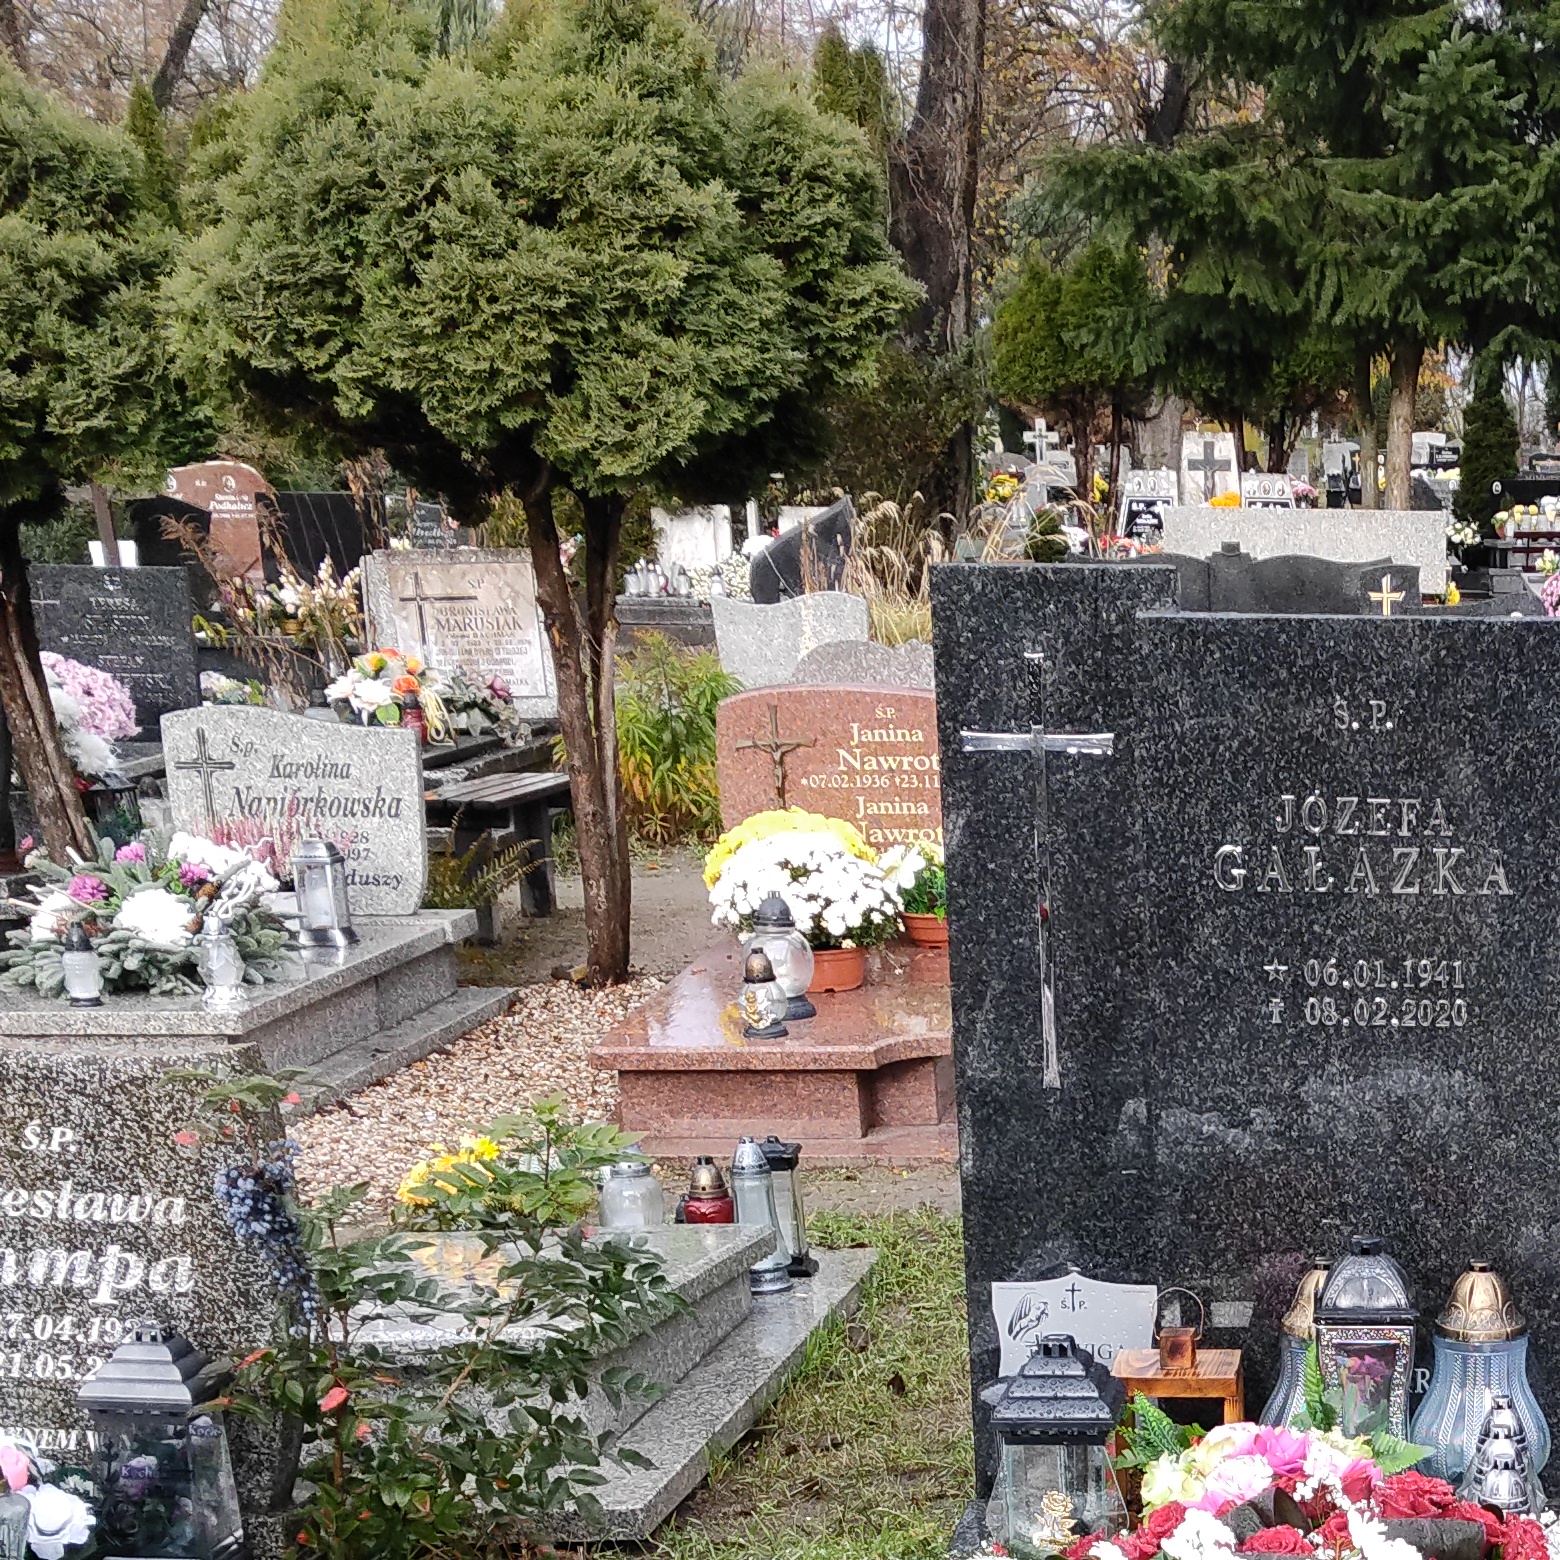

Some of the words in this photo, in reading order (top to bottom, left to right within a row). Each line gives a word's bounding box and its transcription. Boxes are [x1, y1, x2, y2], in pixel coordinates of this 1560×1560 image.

[436, 616, 523, 632] MARUSIAK
[850, 722, 925, 746] Janina
[268, 754, 351, 780] Karolina
[836, 748, 941, 772] Nawrot
[809, 773, 890, 789] 07.02.1936
[900, 774, 940, 789] 23.11
[855, 795, 930, 819] Janina
[1276, 789, 1453, 837] JÓZEFA
[345, 868, 403, 891] duszy
[1304, 957, 1465, 989] 06.01.1941
[1304, 996, 1468, 1027] 08.02.2020
[21, 1119, 77, 1151] Ś.P.
